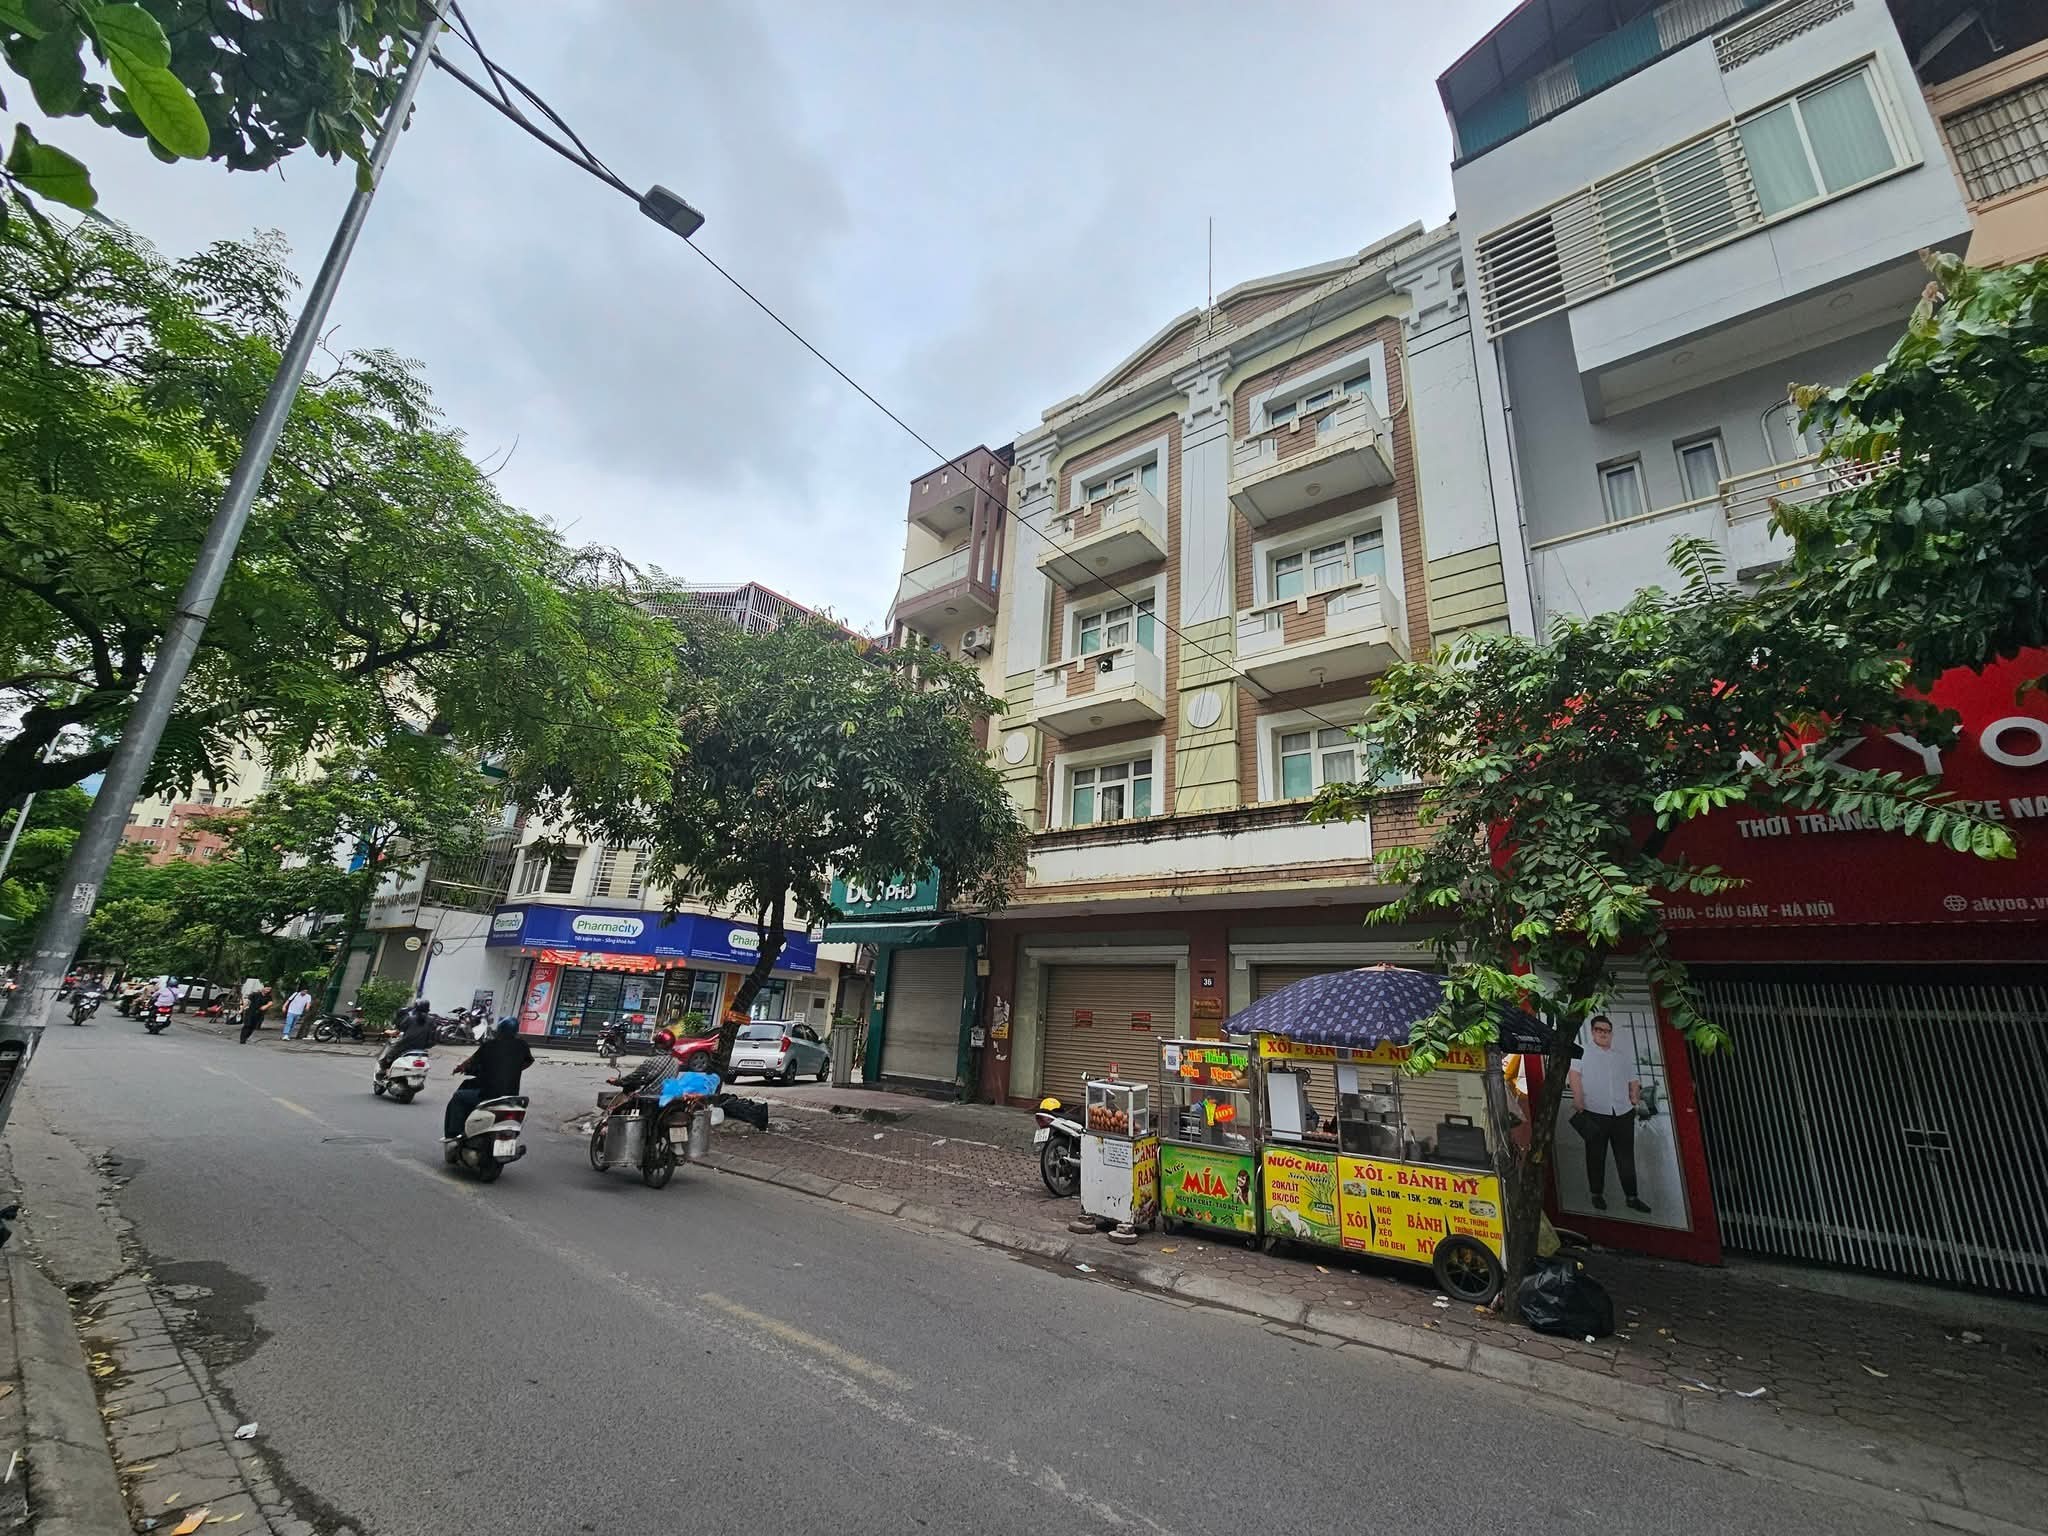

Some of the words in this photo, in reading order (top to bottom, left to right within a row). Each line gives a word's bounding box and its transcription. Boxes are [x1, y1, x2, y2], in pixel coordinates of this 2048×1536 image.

[1736, 815, 1791, 839] THỜI
[577, 919, 639, 935] Pharmacity
[1268, 1155, 1302, 1170] NƯỚC
[1304, 1160, 1329, 1174] MÍA
[1181, 1167, 1229, 1199] MÍA
[1354, 1163, 1383, 1182] XÔI
[1396, 1170, 1448, 1191] BÁNH
[1387, 1189, 1401, 1200] 10K
[1407, 1193, 1421, 1203] 15K
[1428, 1196, 1442, 1206] 20K
[1450, 1199, 1464, 1209] 25K
[1346, 1210, 1369, 1229] XÔI
[1407, 1212, 1443, 1233] BÁNH
